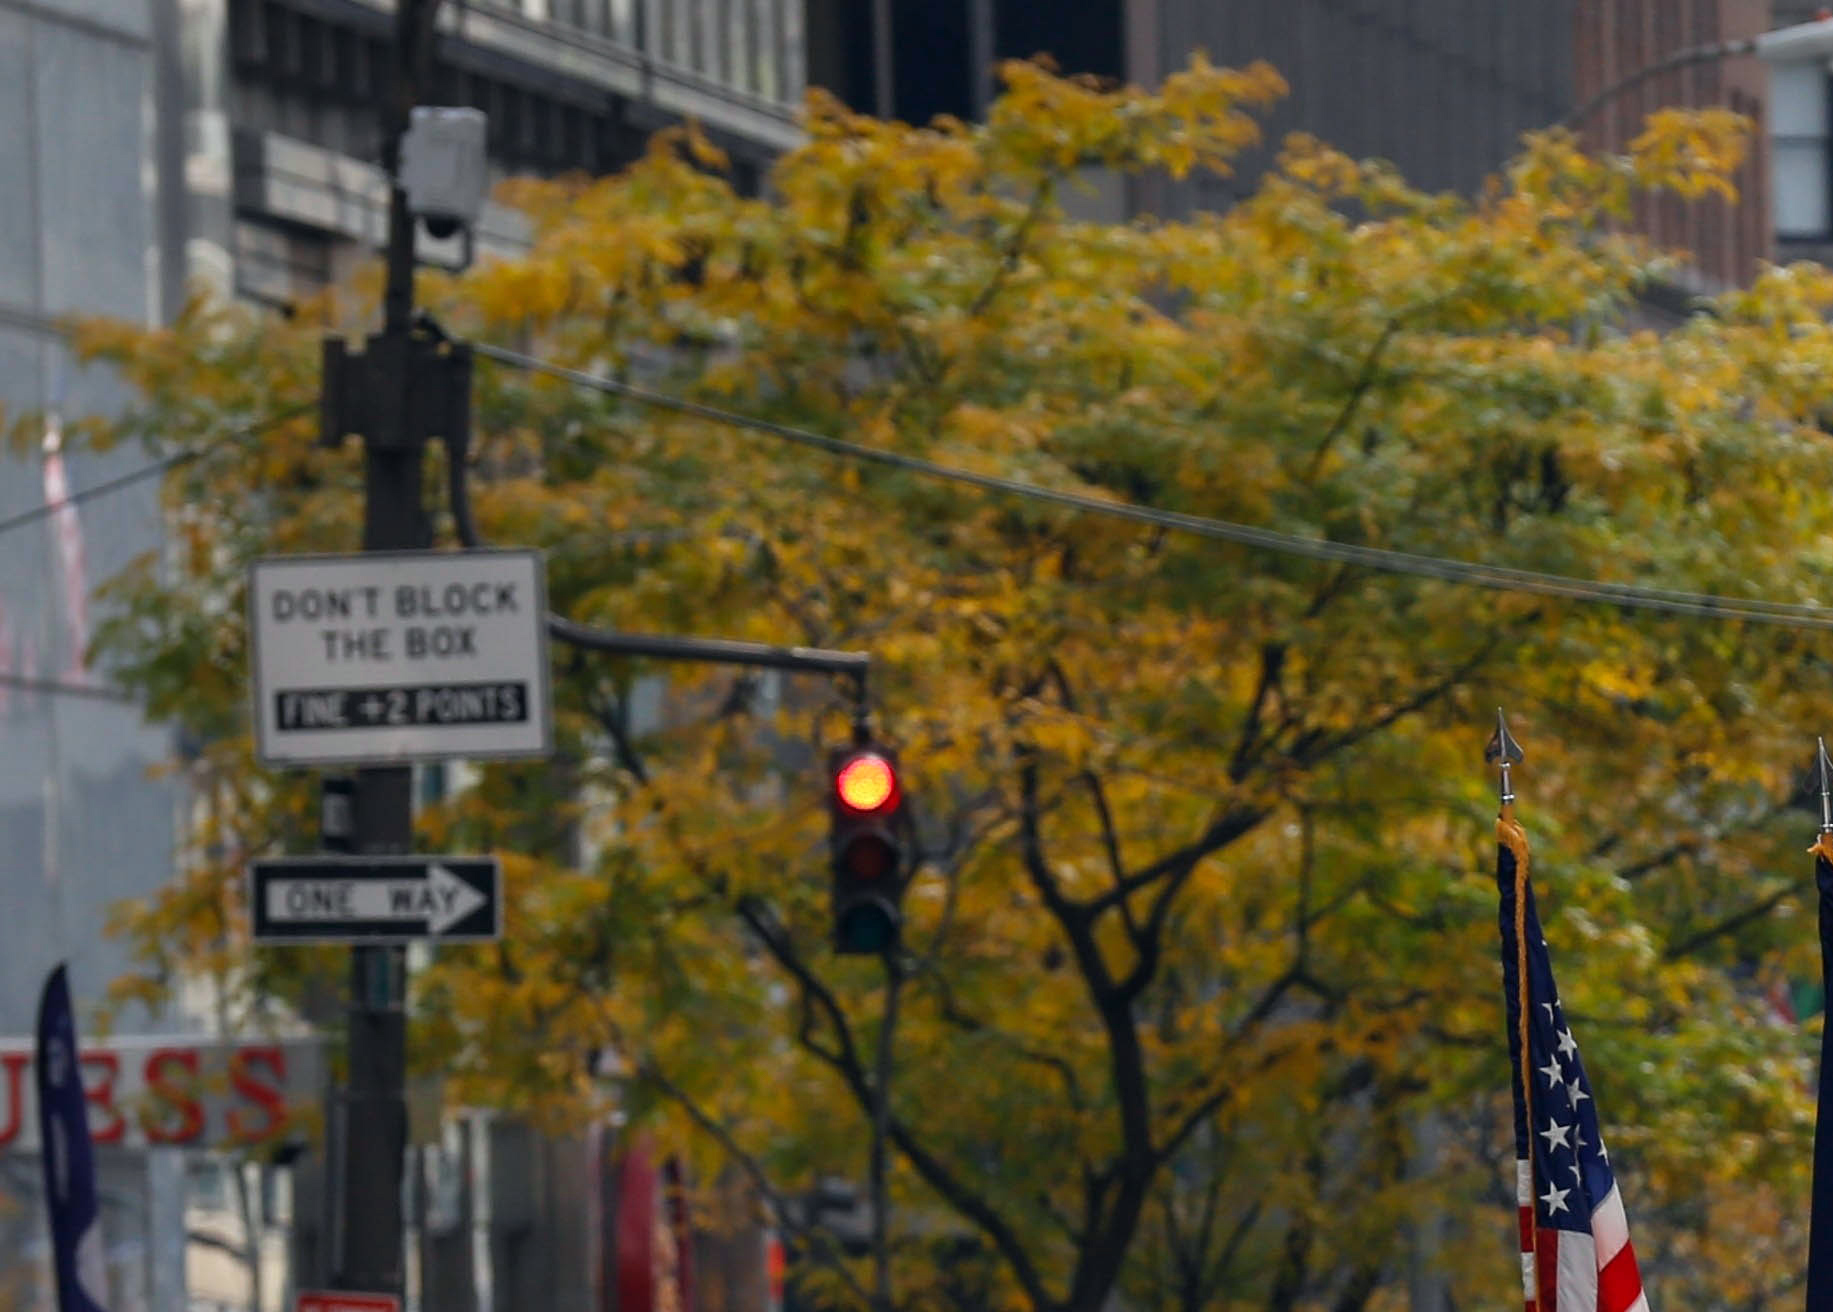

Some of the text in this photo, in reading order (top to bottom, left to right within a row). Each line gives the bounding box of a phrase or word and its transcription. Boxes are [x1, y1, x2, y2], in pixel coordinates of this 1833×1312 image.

[271, 581, 519, 622] DON'T BLOCK
[321, 627, 477, 660] THE BOX
[416, 684, 521, 722] POINTS
[287, 881, 457, 917] ONE WAY
